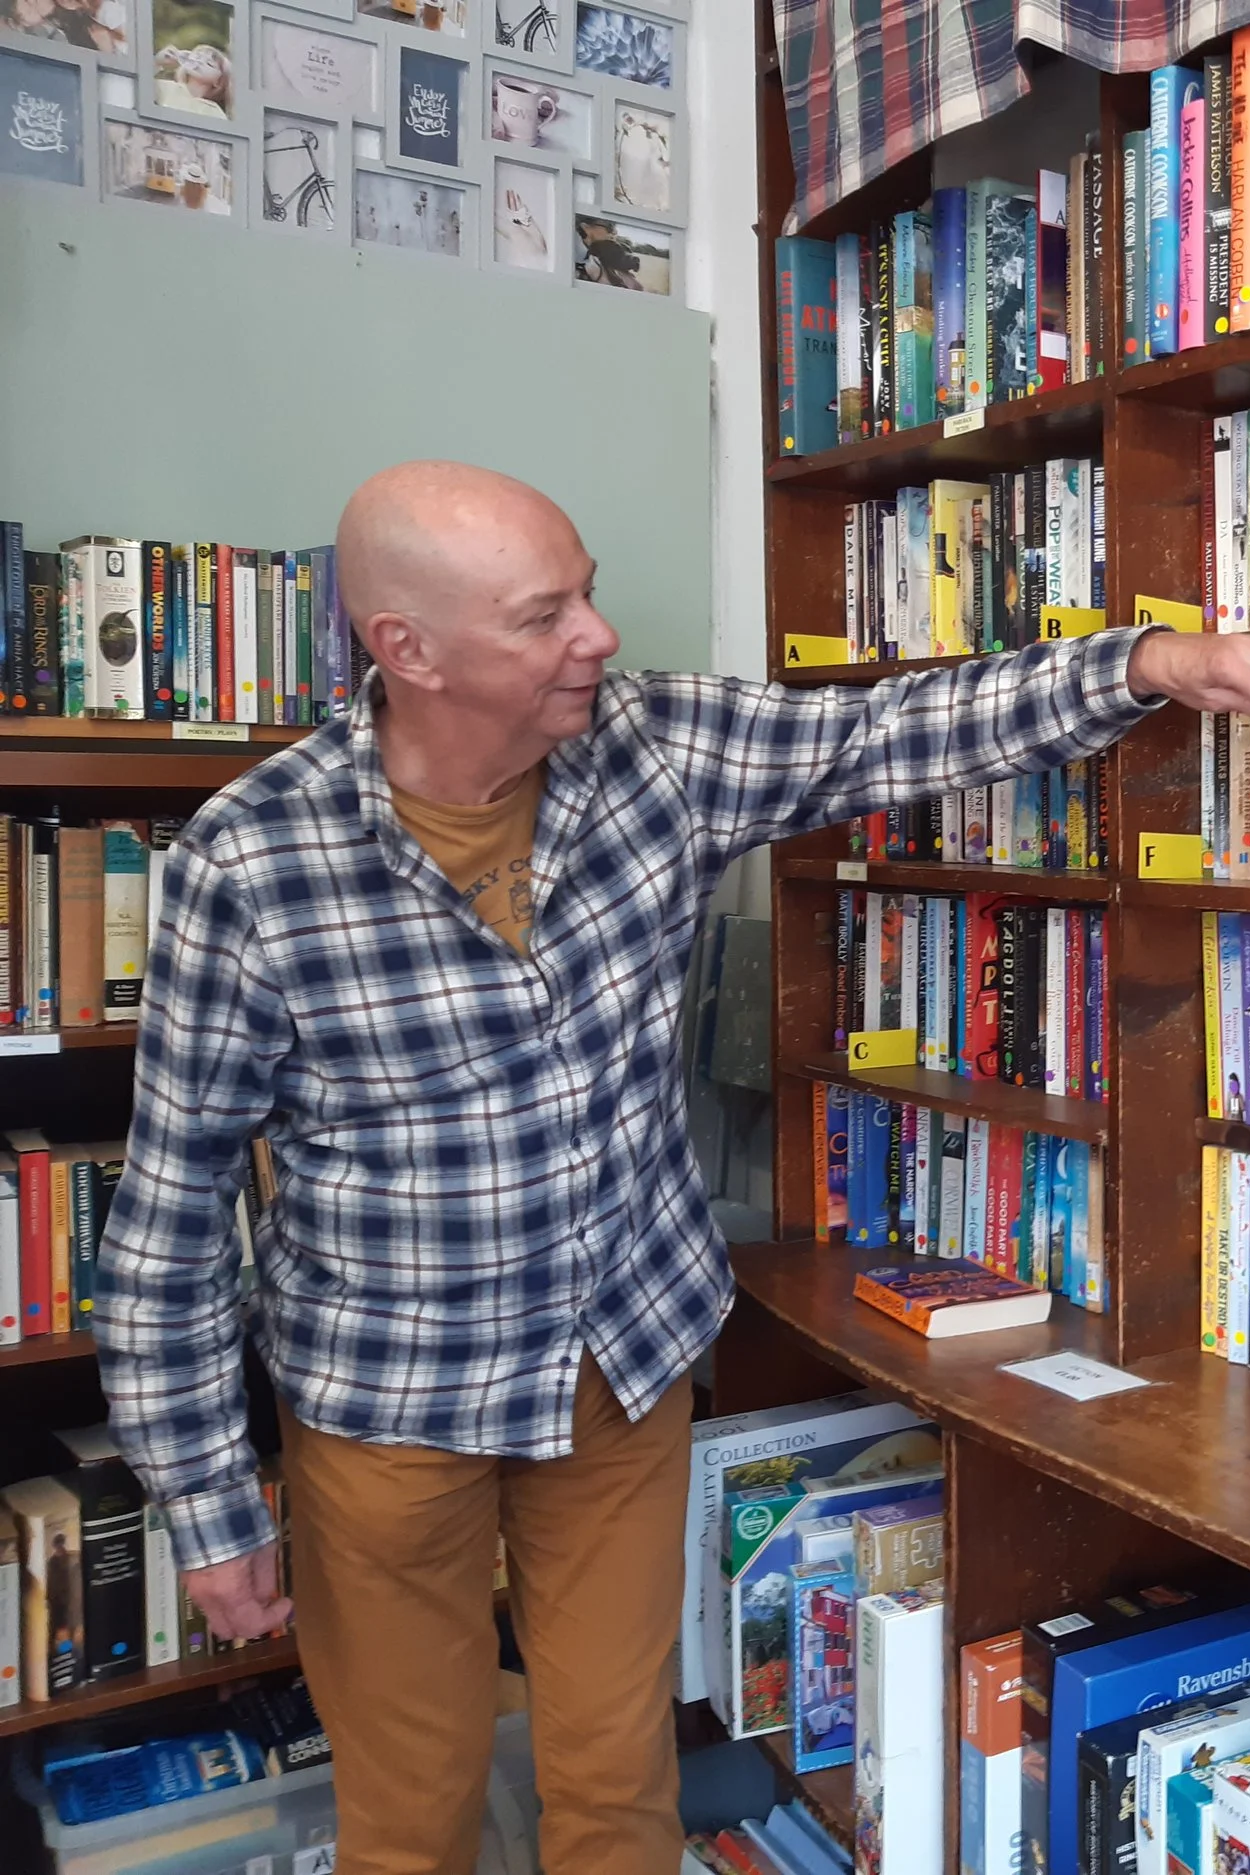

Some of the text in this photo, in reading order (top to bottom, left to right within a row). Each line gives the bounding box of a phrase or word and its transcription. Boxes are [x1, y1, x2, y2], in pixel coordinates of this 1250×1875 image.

[1150, 77, 1168, 148] CATHERINE
[1210, 64, 1222, 194] JAMES PATTERSON
[1123, 149, 1136, 247] CATHERINE COOKSON
[1150, 153, 1168, 219] COOKSON
[1180, 116, 1197, 242] Jackie Collins
[1231, 159, 1245, 232] HARLAN
[1208, 243, 1219, 302] IS MISSING
[1218, 235, 1229, 307] PRESIDENT
[968, 282, 978, 379] Chestnut Street
[151, 546, 164, 651] OTHERWORLDS
[846, 528, 855, 613] DARE ME
[32, 627, 50, 667] RINGS
[1046, 617, 1062, 639] B
[1139, 609, 1152, 626] D
[787, 644, 801, 663] A
[1144, 846, 1156, 868] F
[837, 892, 850, 961] MATT BROLLY
[854, 1042, 869, 1060] C
[997, 1191, 1009, 1256] GOOD PART
[703, 1431, 817, 1468] COLLECTION
